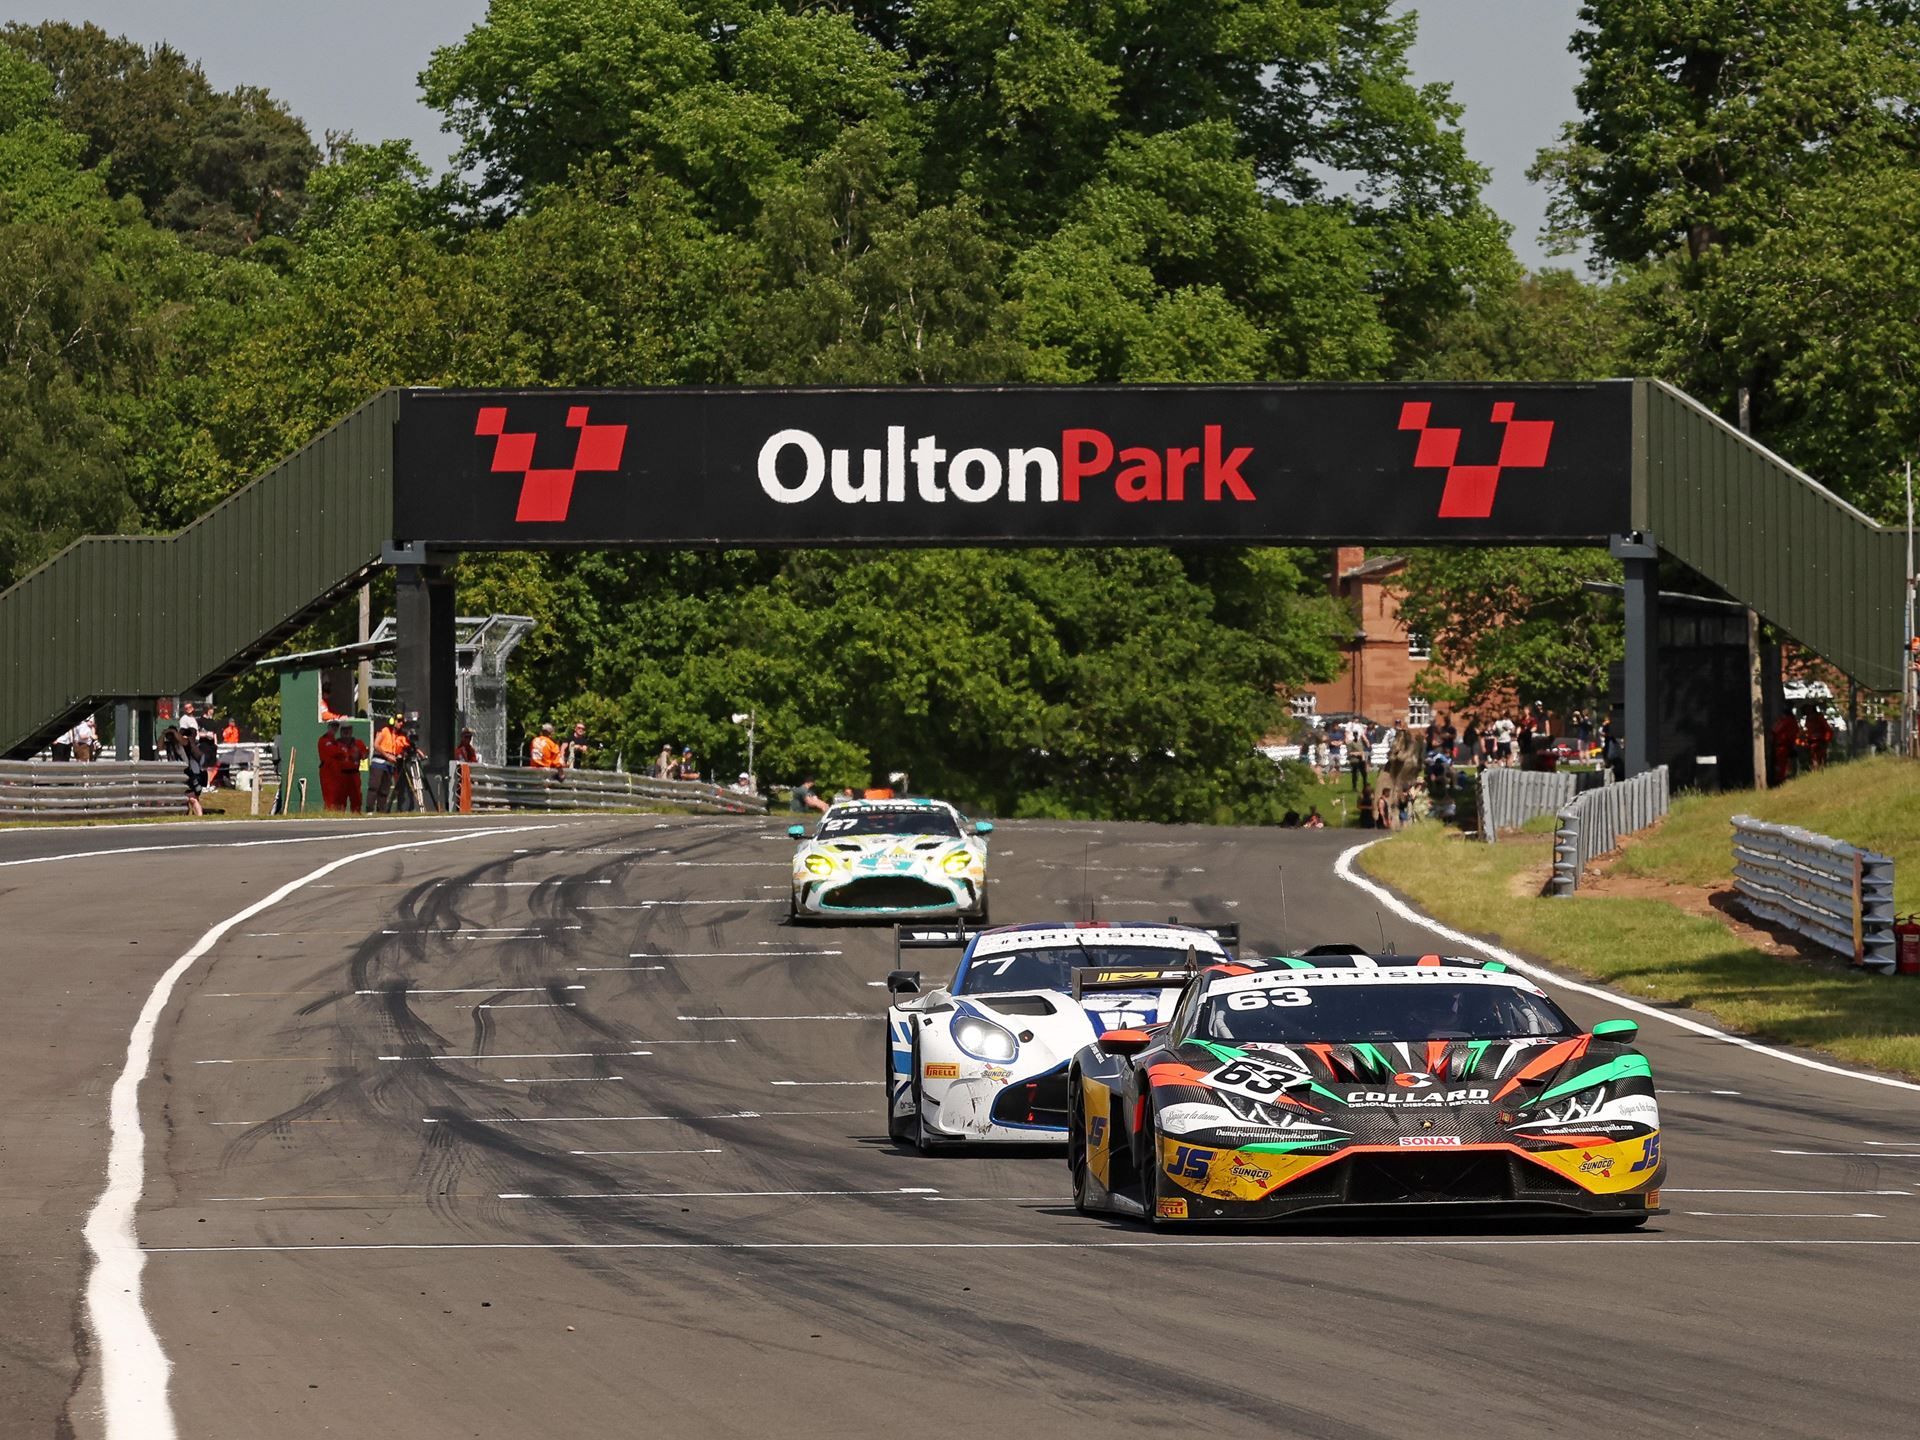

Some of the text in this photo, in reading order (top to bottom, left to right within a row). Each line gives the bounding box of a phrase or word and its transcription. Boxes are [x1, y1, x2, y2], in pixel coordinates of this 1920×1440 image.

[757, 425, 1256, 504] OultonPark
[824, 818, 859, 832] 27
[1001, 932, 1188, 944] #BRITISHGT
[1252, 971, 1493, 984] #BRITISHGT
[1226, 987, 1313, 1011] 63
[926, 1065, 957, 1076] PIRELLI
[982, 1069, 1012, 1078] SUNOCO
[1213, 1061, 1297, 1094] 63
[1347, 1089, 1490, 1103] COLLARD
[1215, 1128, 1319, 1141] DamaFortunaTequila.com
[1542, 1123, 1634, 1136] DamaFortunaTequila.com
[1401, 1137, 1456, 1146] SONAX
[1580, 1159, 1613, 1171] SUNOCO
[1232, 1166, 1271, 1179] SUNOCO
